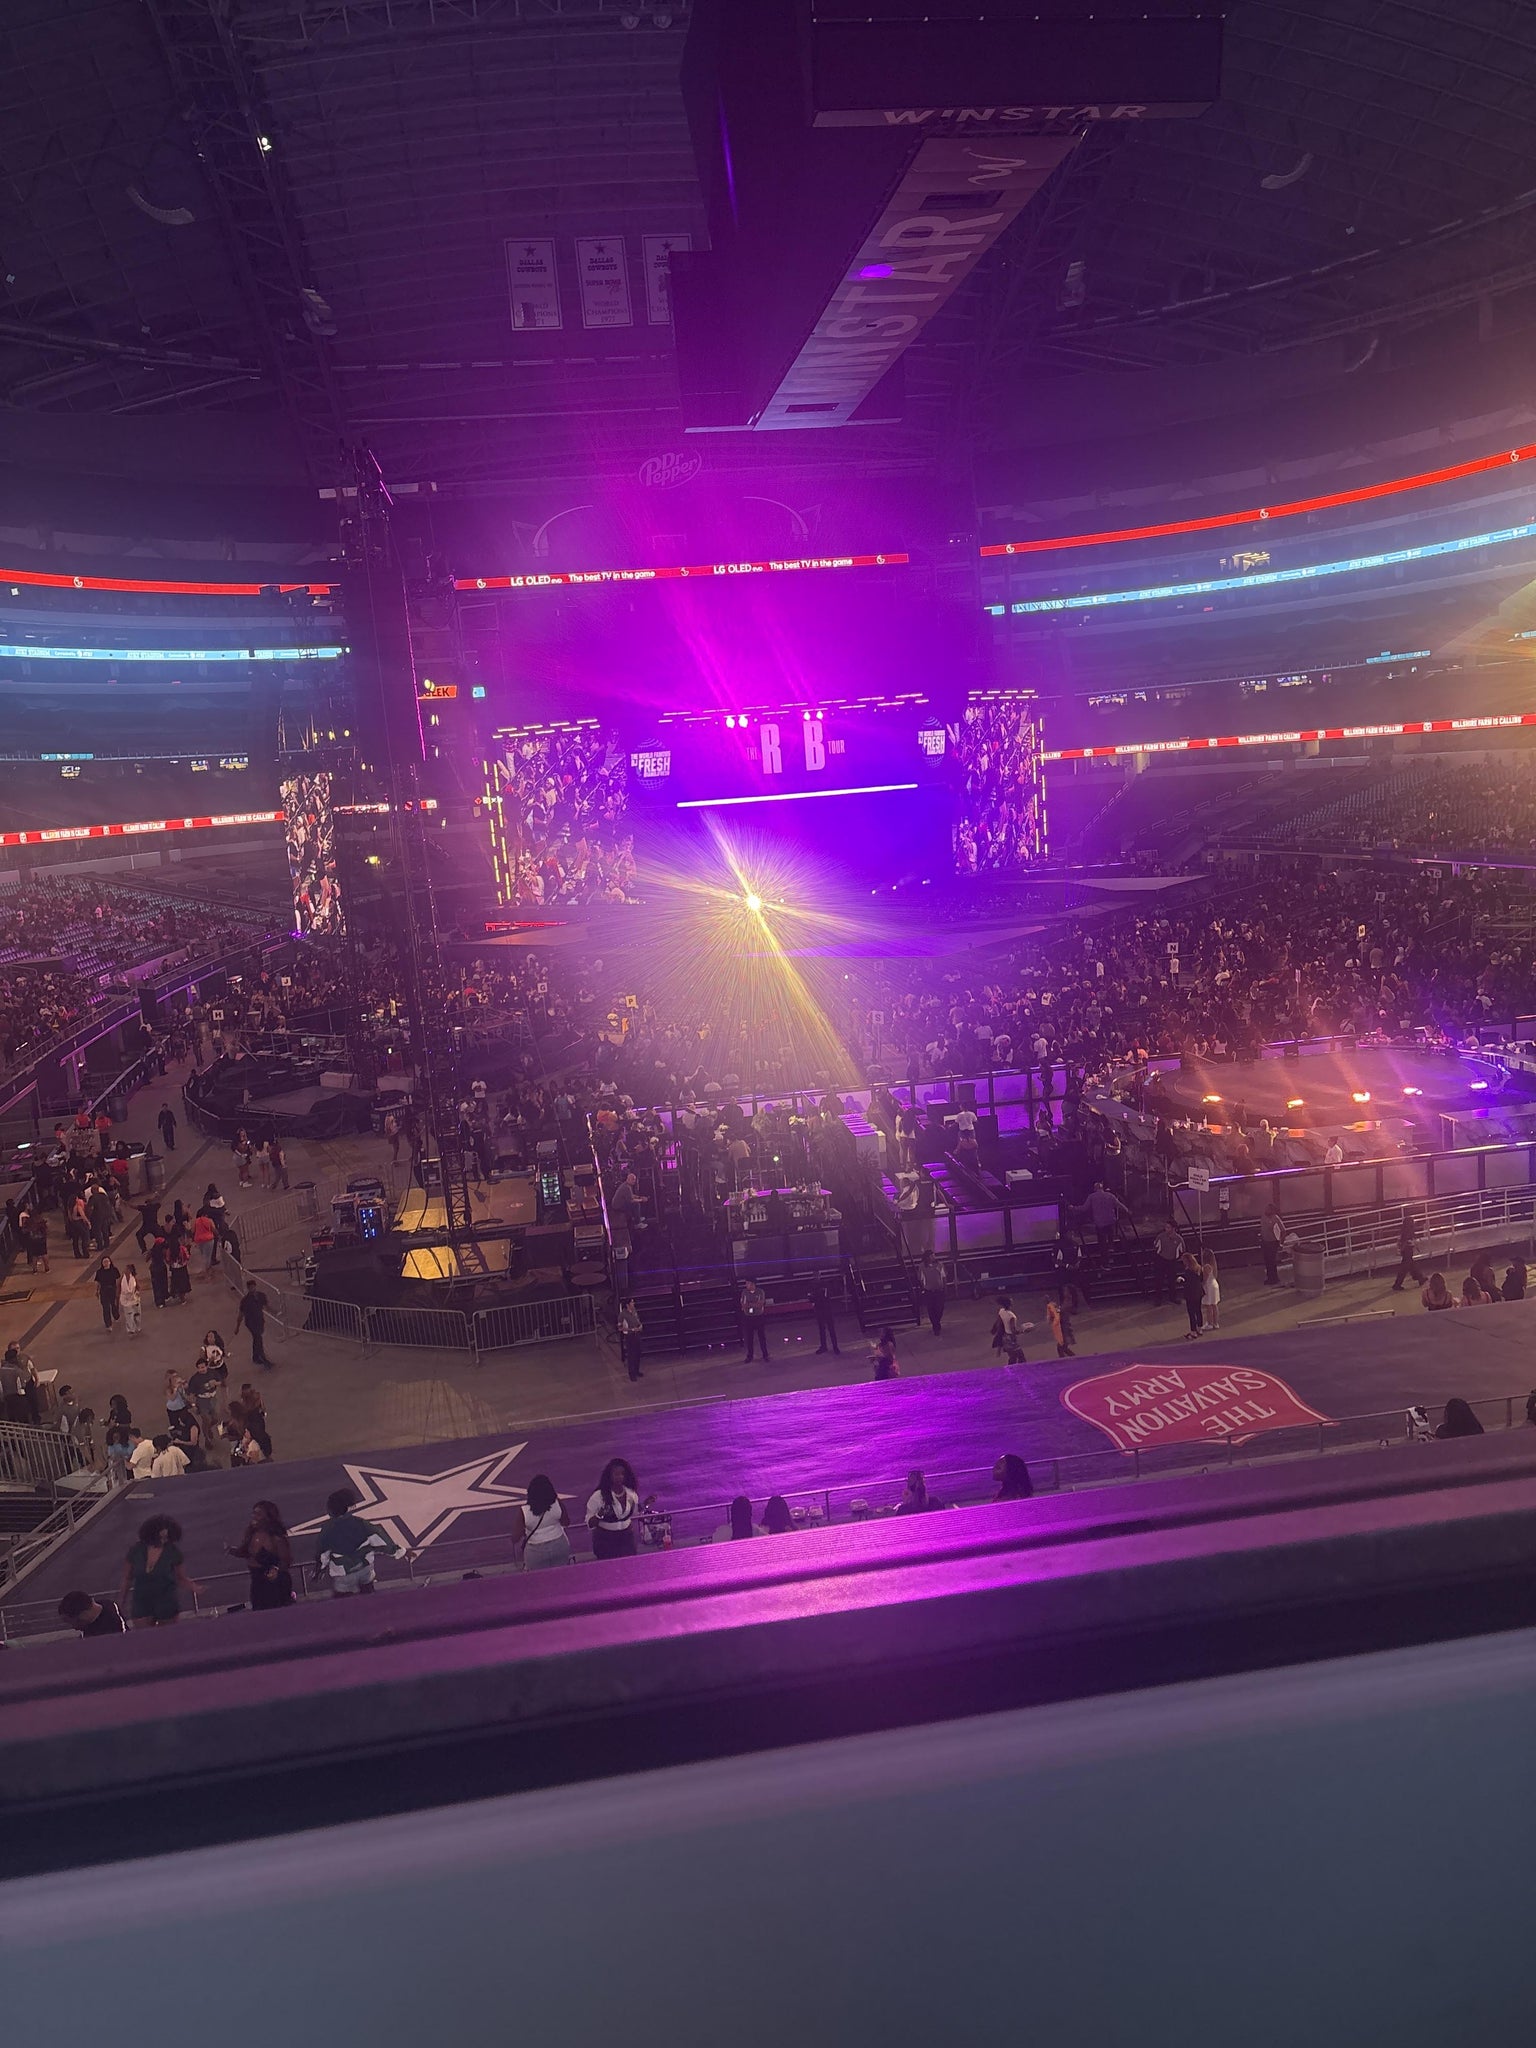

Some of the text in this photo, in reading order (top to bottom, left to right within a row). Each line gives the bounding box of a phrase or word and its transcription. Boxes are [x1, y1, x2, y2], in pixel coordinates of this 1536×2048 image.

[884, 105, 1146, 124] WINSTAR
[662, 452, 684, 469] Dr
[645, 456, 698, 487] Pepper
[713, 565, 726, 574] LG
[727, 563, 751, 573] OLED
[769, 562, 783, 570] The
[784, 561, 800, 569] best
[801, 560, 811, 568] TV
[820, 559, 832, 567] the
[511, 576, 524, 586] LG
[526, 575, 551, 585] OLED
[569, 574, 583, 583] The
[584, 573, 601, 581] best
[601, 572, 612, 580] TV
[621, 571, 633, 579] the
[760, 723, 783, 774] R
[802, 720, 826, 771] B
[827, 740, 846, 754] TOUR
[923, 736, 945, 751] FRESH
[639, 757, 671, 772] FRESH
[1103, 1369, 1187, 1416] ARMY
[1115, 1371, 1267, 1443] SALVATION
[1200, 1400, 1277, 1436] THE
